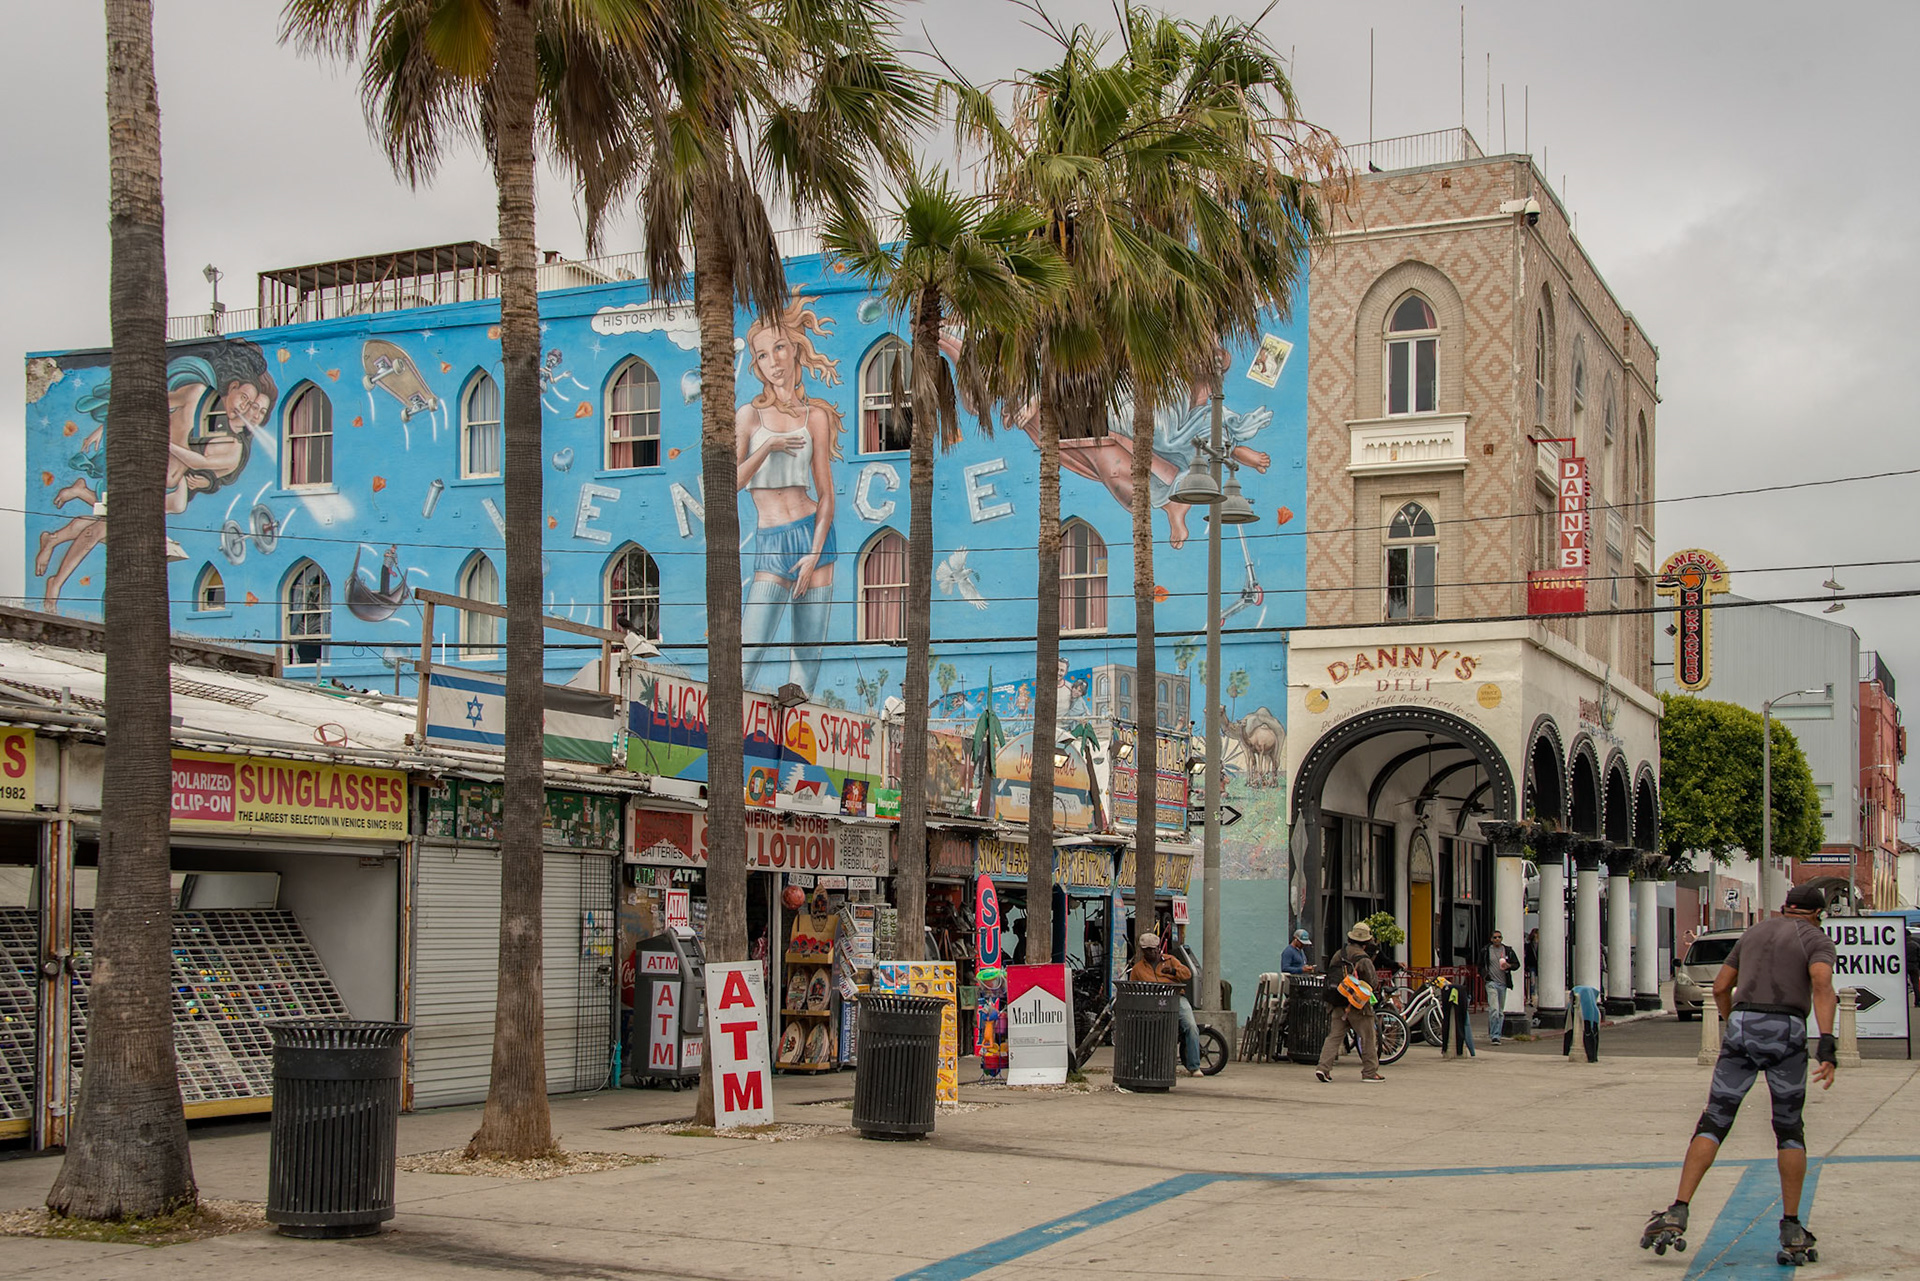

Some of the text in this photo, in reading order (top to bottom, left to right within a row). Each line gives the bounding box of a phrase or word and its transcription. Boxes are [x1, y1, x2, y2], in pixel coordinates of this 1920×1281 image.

[603, 311, 657, 327] HISTORY
[1564, 462, 1582, 566] DANNYS
[1533, 575, 1583, 589] VENICE
[1684, 592, 1699, 682] BACKPACKERS
[1326, 645, 1478, 685] DANNY'S
[1376, 677, 1433, 692] DELI
[653, 681, 709, 734] LUCK
[818, 713, 871, 761] STORE
[171, 770, 232, 793] POLARIZED
[239, 763, 403, 814] SUNGLASSES
[171, 790, 232, 813] CLIP-ON
[877, 797, 899, 811] Newport
[238, 811, 403, 831] THE LARGEST SELECTION IN VENICE SINCE 1982
[794, 816, 829, 834] STORE
[839, 833, 883, 847] SPORTS TOYS
[641, 844, 684, 860] BATTERIES
[757, 832, 835, 871] LOTION
[843, 845, 886, 859] BEACH TOWEL
[843, 858, 871, 870] REDBULL
[852, 878, 872, 888] TOBACCO
[668, 894, 688, 919] ATM
[1174, 902, 1187, 919] ATM
[1820, 925, 1896, 945] UBLIC
[646, 955, 678, 970] ATM
[1832, 954, 1901, 975] RKING
[1012, 999, 1063, 1025] Marlboro
[652, 984, 674, 1066] ATM
[718, 970, 764, 1112] ATM
